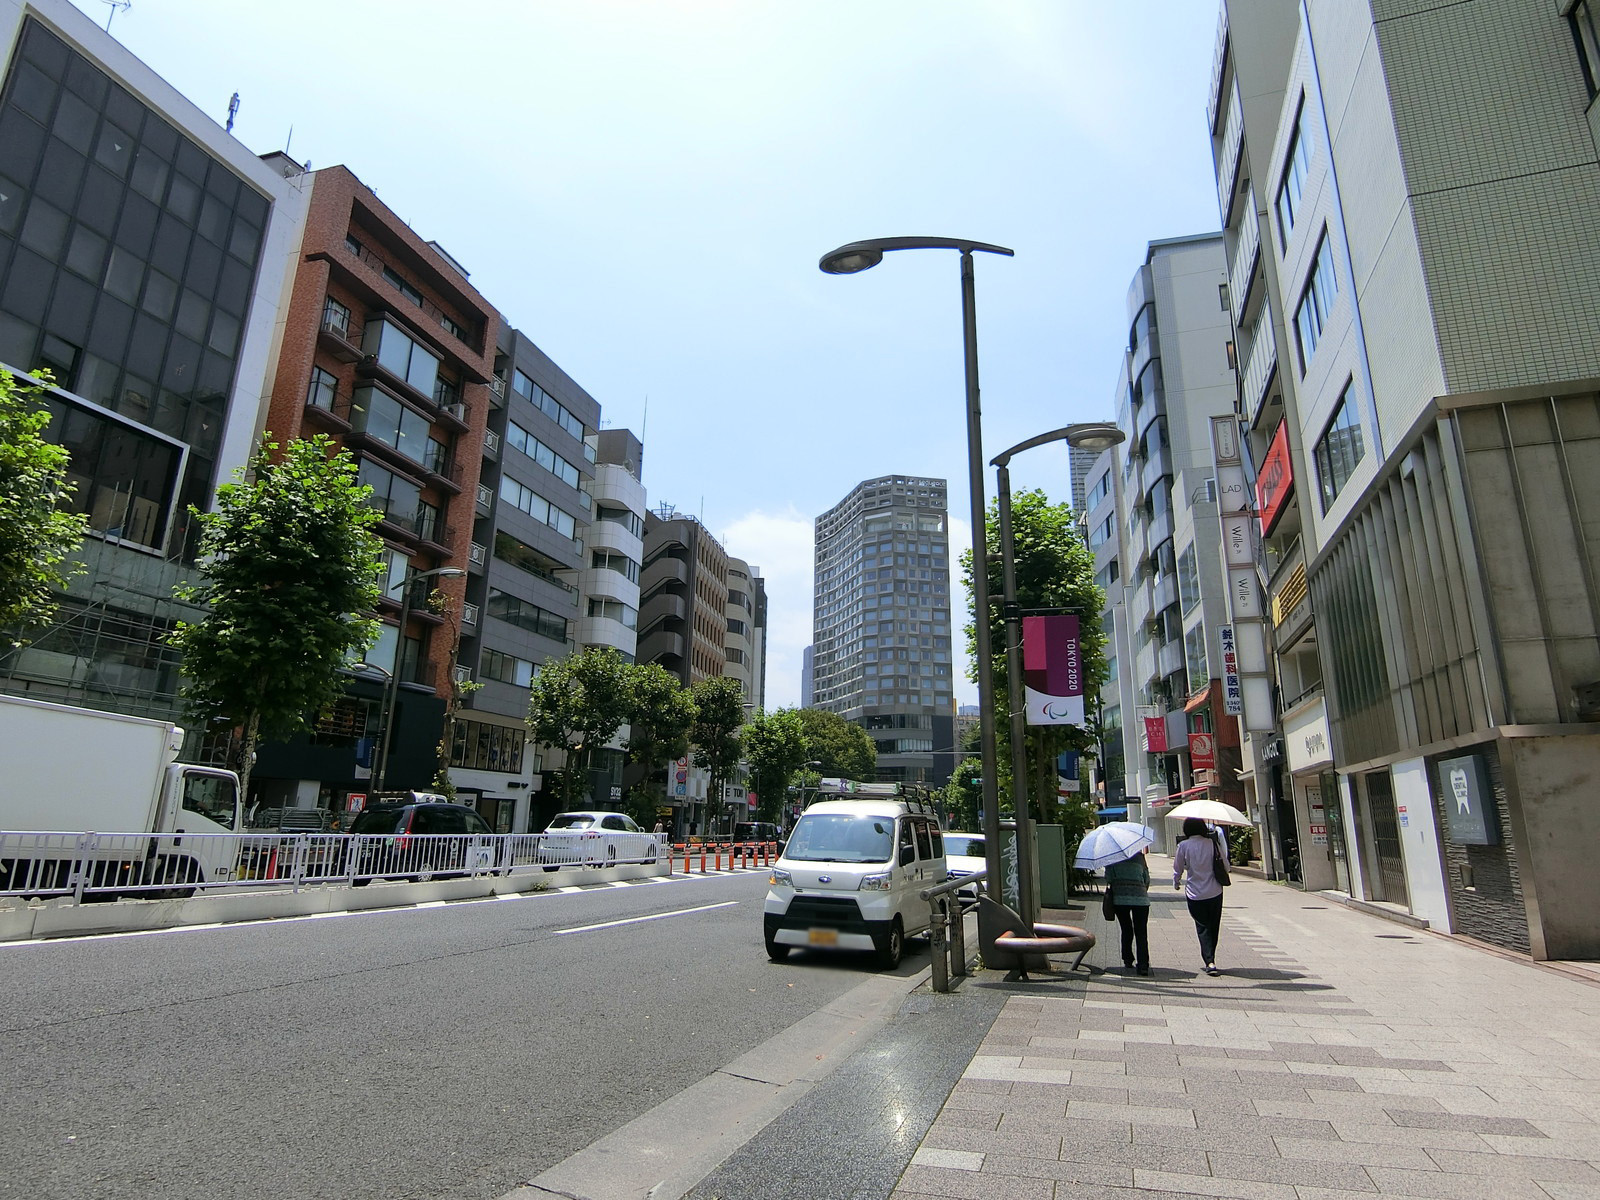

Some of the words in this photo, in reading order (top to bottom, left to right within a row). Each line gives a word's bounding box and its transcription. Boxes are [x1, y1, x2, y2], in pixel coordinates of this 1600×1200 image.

[1221, 484, 1242, 493] LAD
[1232, 526, 1243, 548] Wille
[1238, 578, 1250, 601] Wille
[1067, 637, 1077, 667] TOKYO
[1068, 668, 1078, 691] 2020
